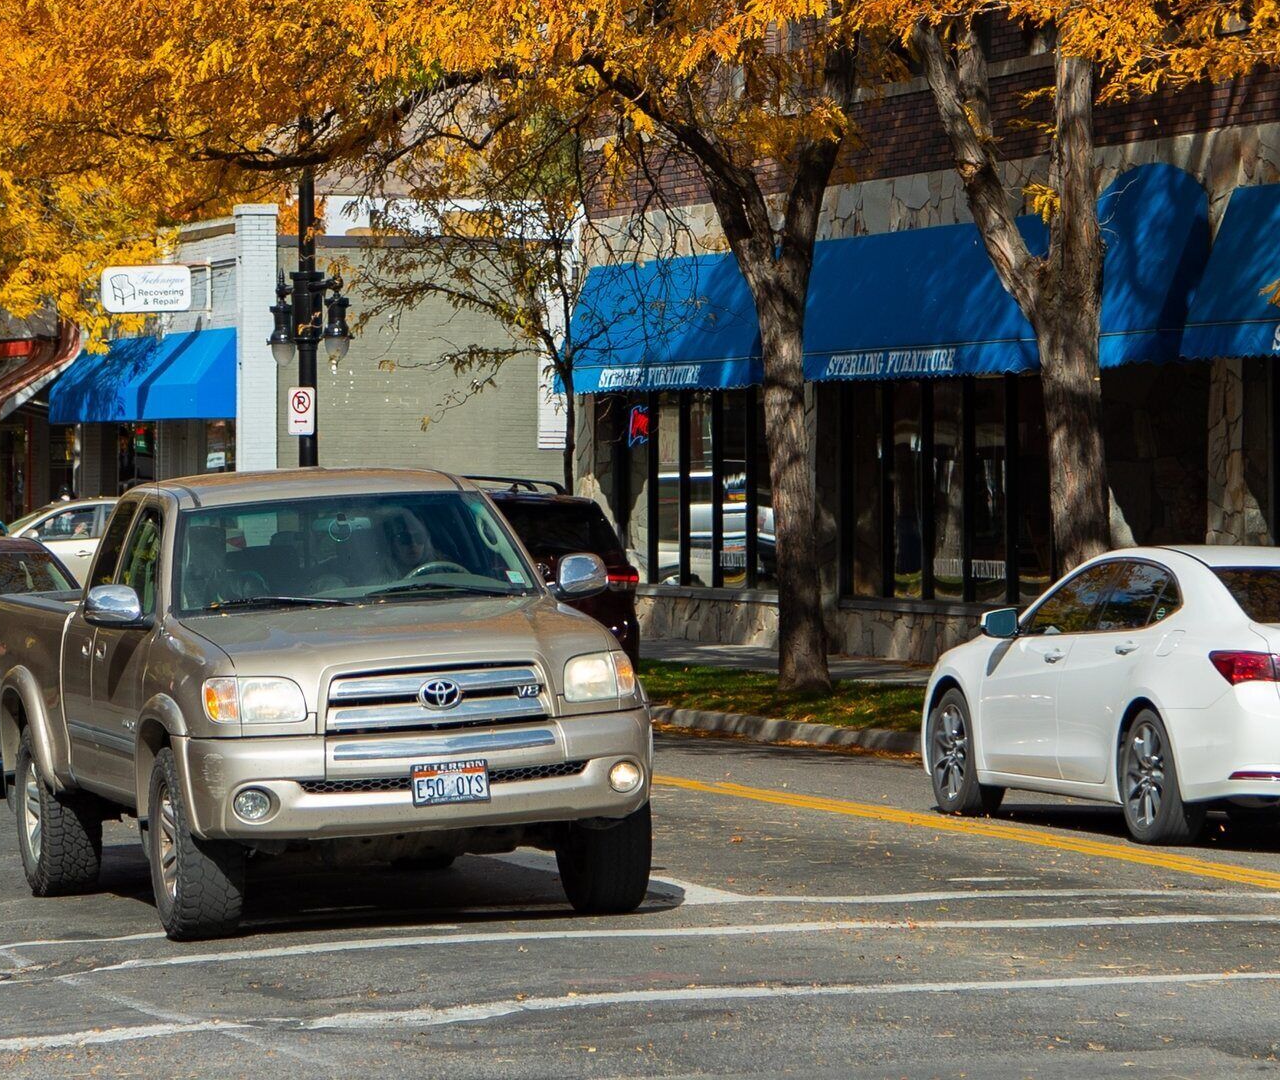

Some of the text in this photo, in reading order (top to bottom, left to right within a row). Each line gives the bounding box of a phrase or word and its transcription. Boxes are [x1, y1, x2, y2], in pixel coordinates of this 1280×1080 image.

[152, 298, 180, 306] Repair
[826, 348, 956, 376] STERLING FURNITURE
[971, 559, 1007, 579] FURNITUR
[517, 685, 539, 697] V8
